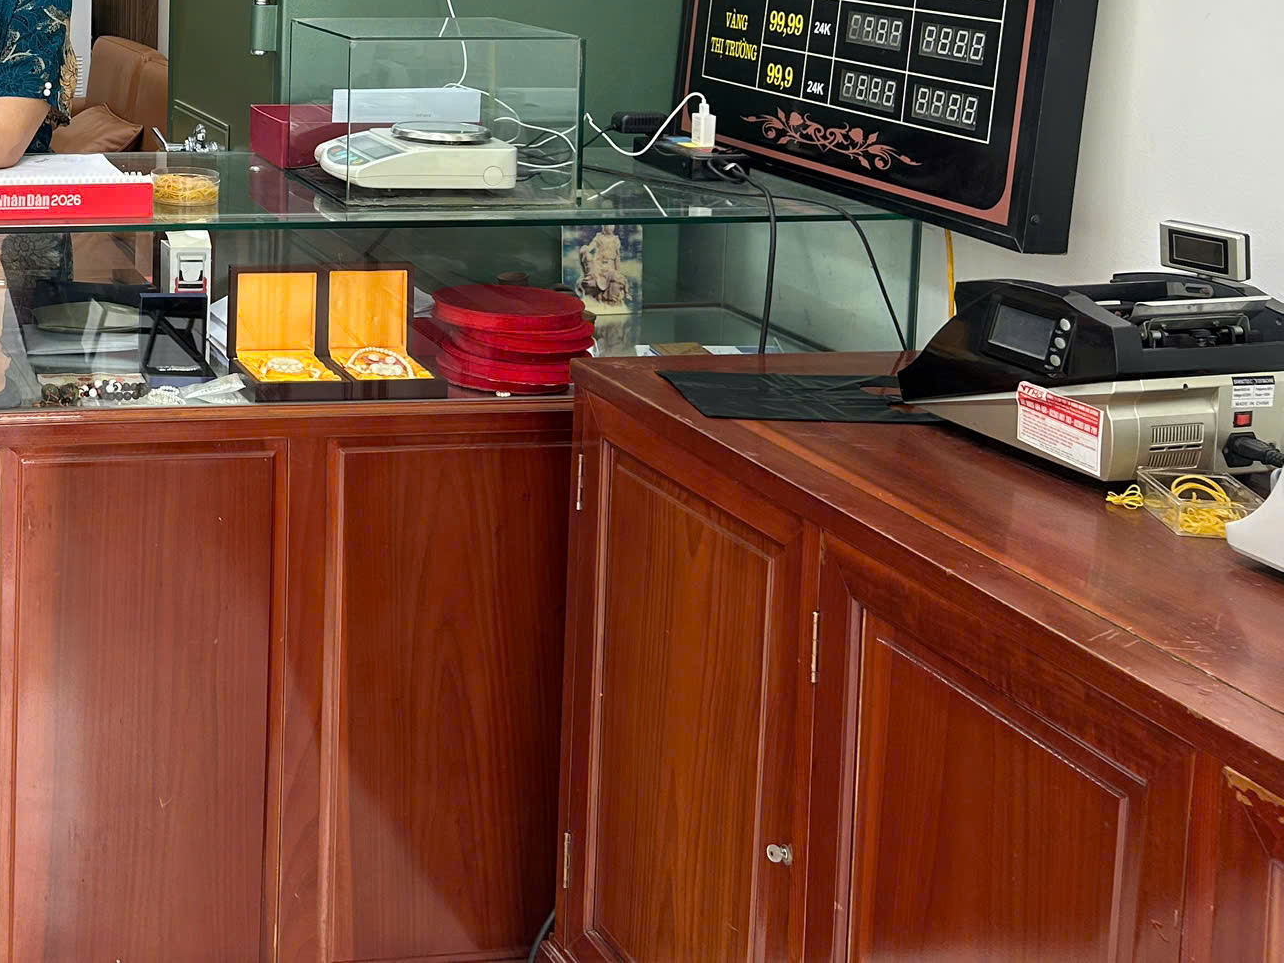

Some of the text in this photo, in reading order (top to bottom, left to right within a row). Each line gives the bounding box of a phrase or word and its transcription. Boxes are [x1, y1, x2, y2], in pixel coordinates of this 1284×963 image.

[726, 8, 748, 31] VÀNG
[769, 10, 804, 37] 99,99
[814, 21, 832, 36] 24K
[711, 37, 724, 58] THỊ
[766, 63, 793, 90] 99,9
[806, 80, 824, 96] 24K
[27, 194, 50, 207] Dân
[51, 194, 82, 206] 2026
